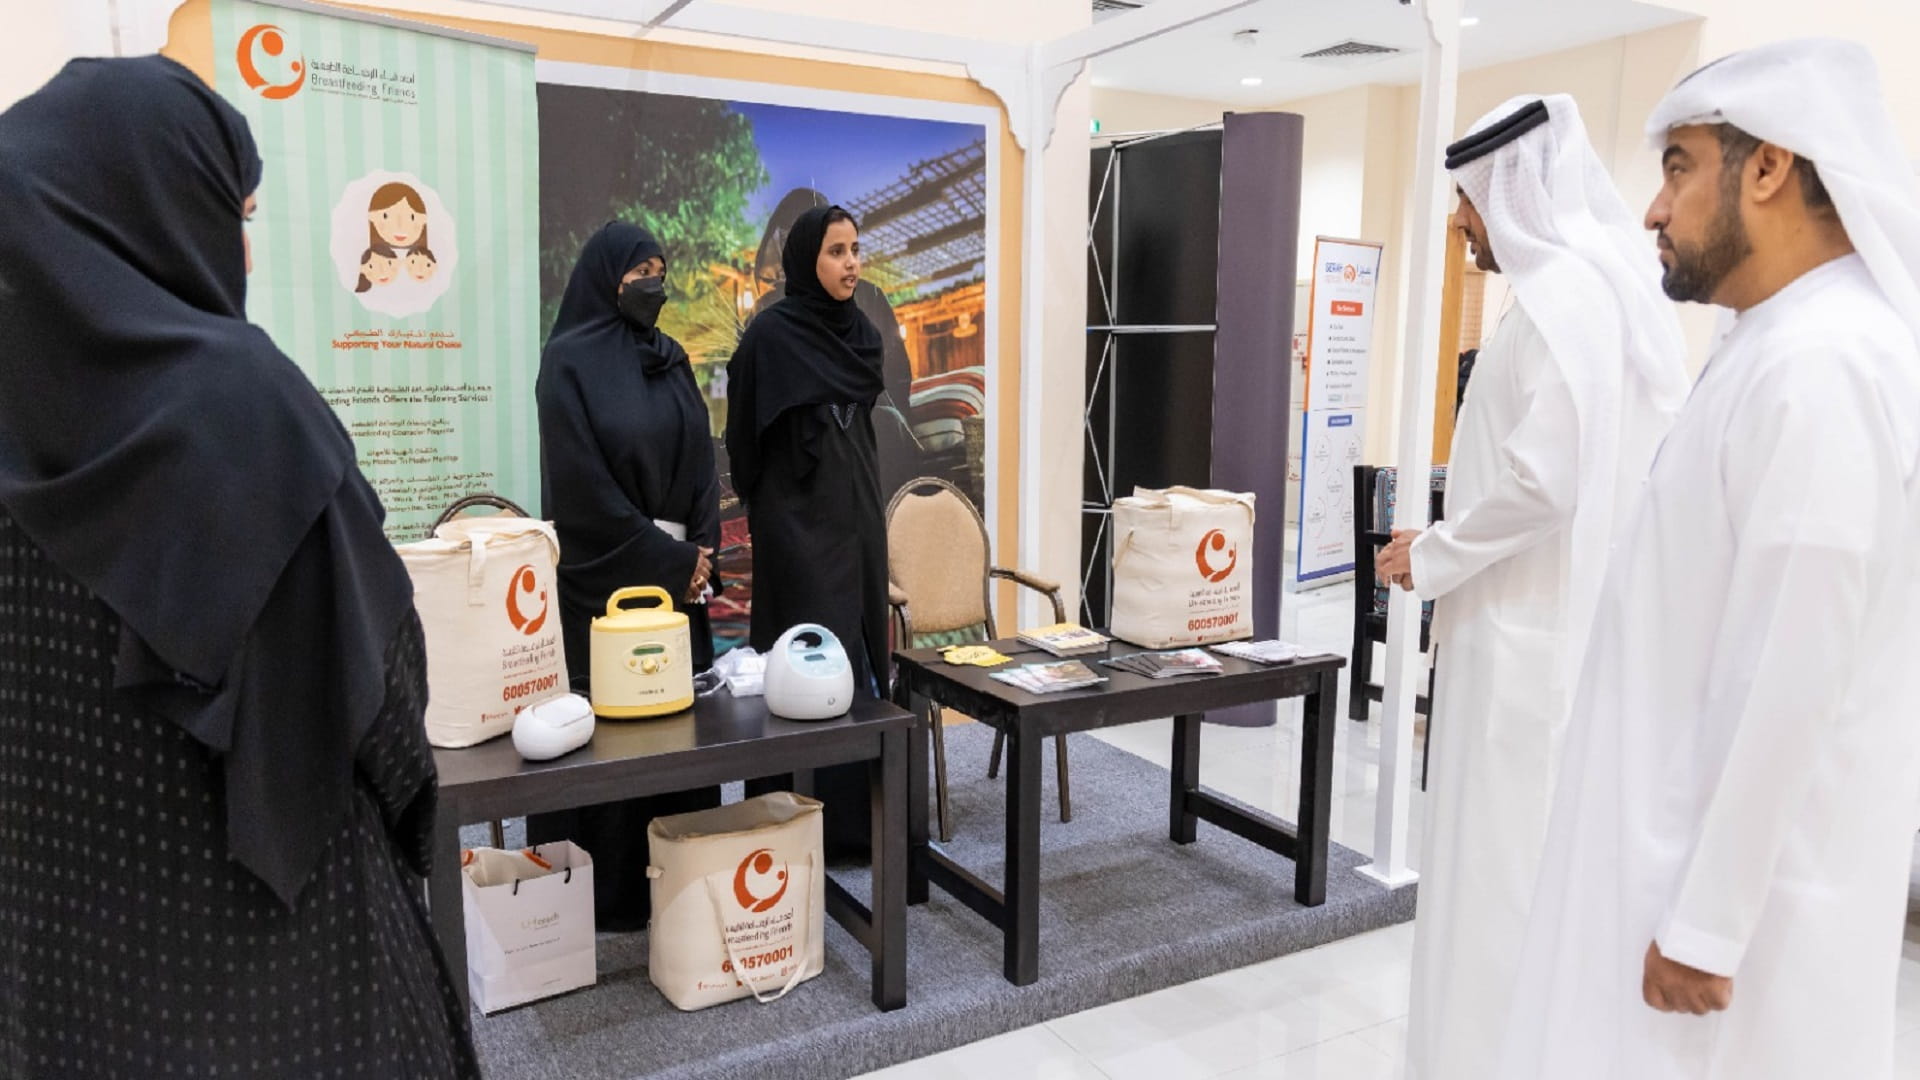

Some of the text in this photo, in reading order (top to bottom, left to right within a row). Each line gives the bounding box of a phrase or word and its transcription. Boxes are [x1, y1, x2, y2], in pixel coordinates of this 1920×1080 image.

[311, 73, 378, 96] Breastfeeding
[382, 83, 416, 99] Friends
[332, 339, 462, 350] Supporting Your Natural Choice
[1187, 612, 1239, 632] 600570001
[503, 672, 558, 702] 600570001
